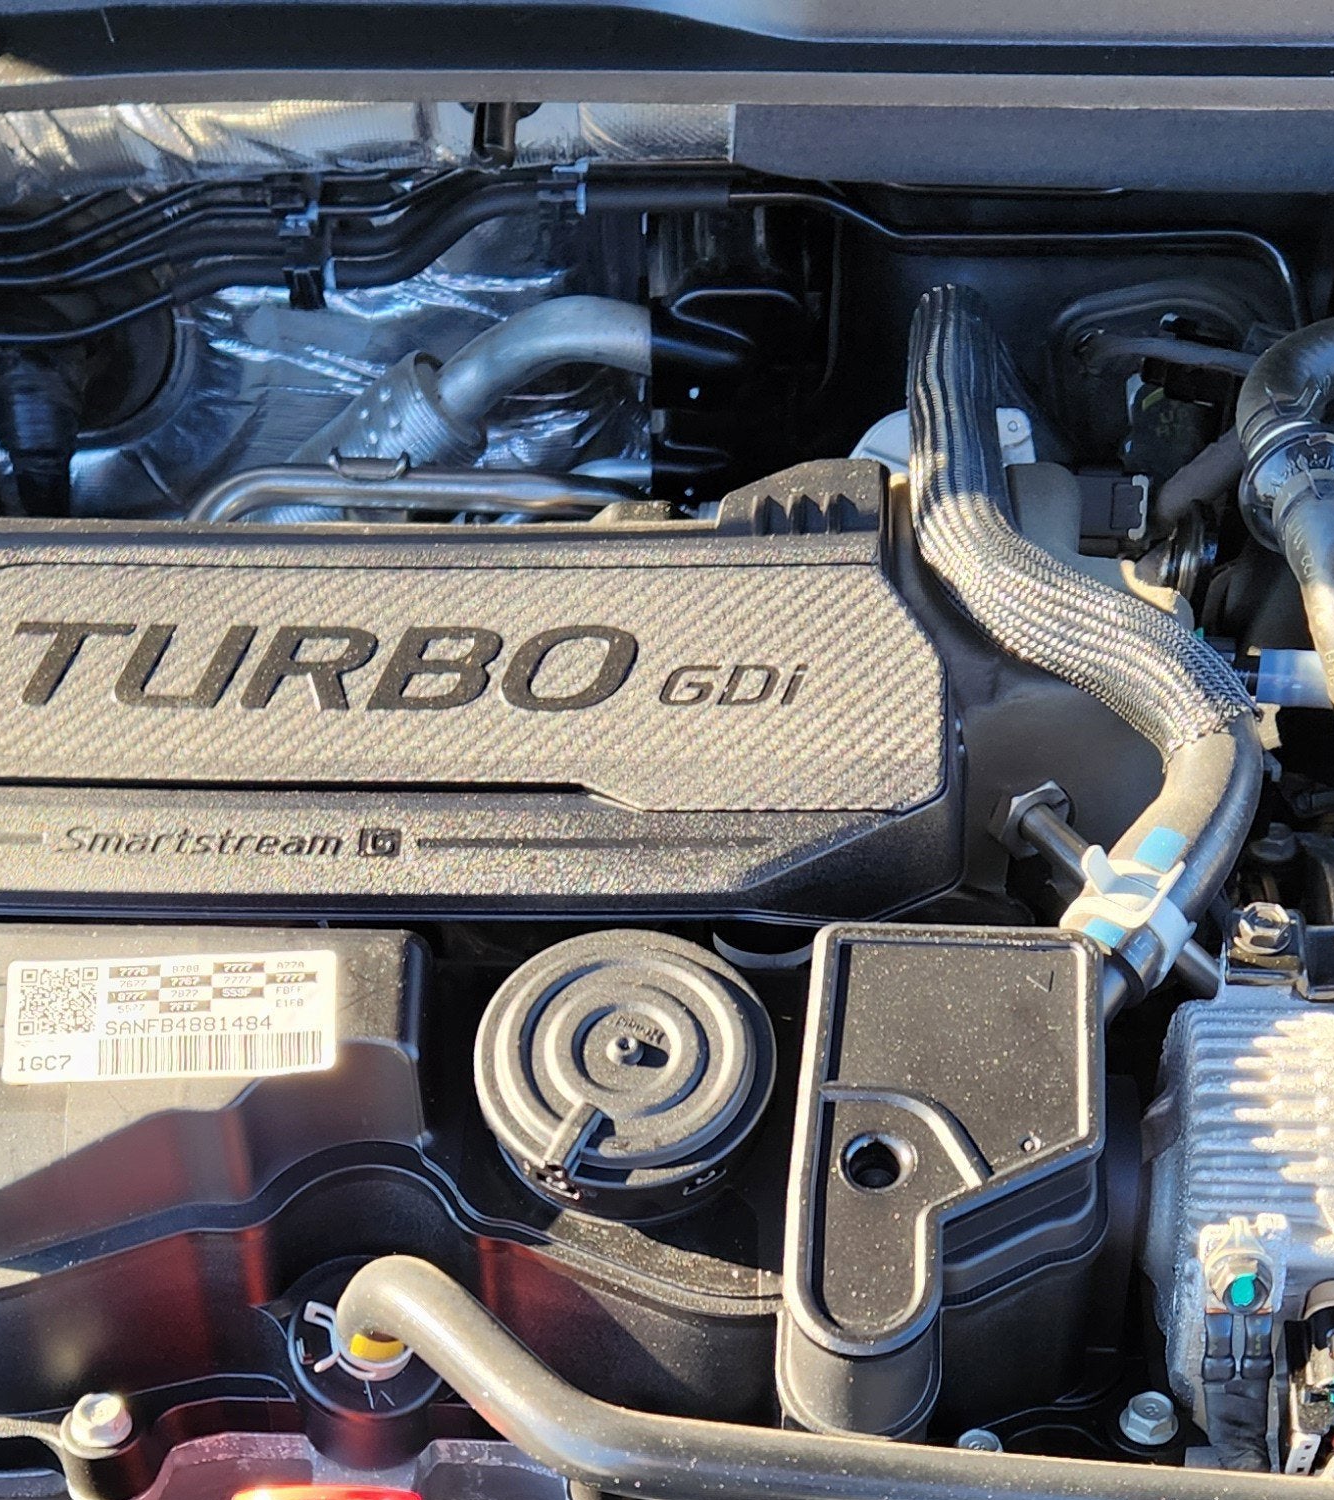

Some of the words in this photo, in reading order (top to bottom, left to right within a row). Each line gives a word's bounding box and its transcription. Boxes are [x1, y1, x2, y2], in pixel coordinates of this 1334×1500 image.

[14, 621, 639, 710] TURBO
[657, 662, 806, 706] GDi
[56, 826, 344, 857] Smartstream
[105, 1016, 272, 1036] SANFB4881484
[17, 1055, 71, 1072] 1GC7
